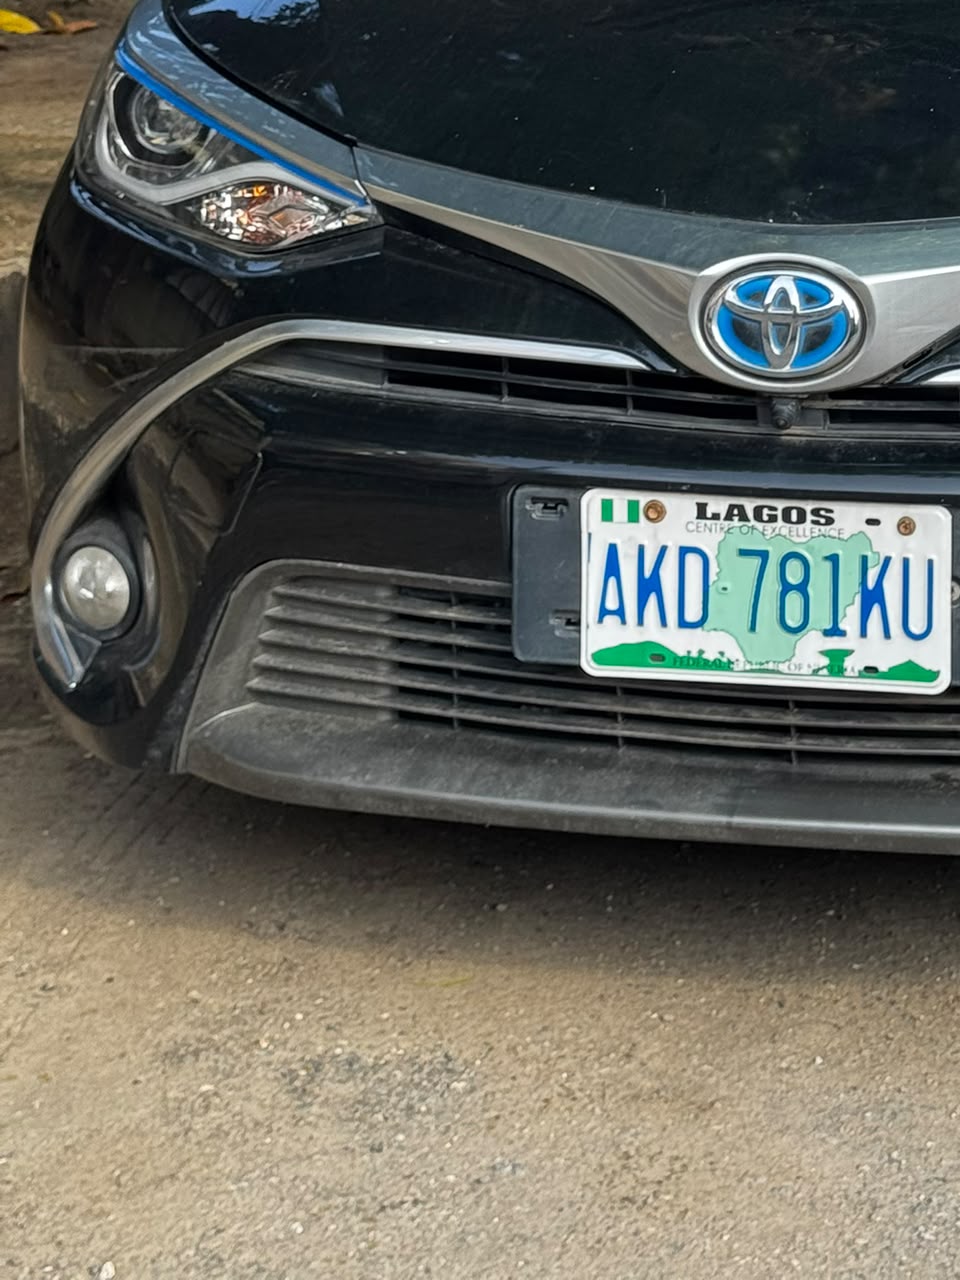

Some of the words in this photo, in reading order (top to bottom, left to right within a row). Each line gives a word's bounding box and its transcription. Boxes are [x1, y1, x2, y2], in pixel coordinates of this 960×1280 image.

[695, 501, 836, 527] LAGOS
[685, 520, 732, 535] CENTRE
[738, 524, 756, 536] OF
[762, 525, 845, 540] EXCELLENCE
[597, 542, 711, 630] AKD
[672, 656, 728, 669] FEDERAL
[787, 661, 805, 673] OF
